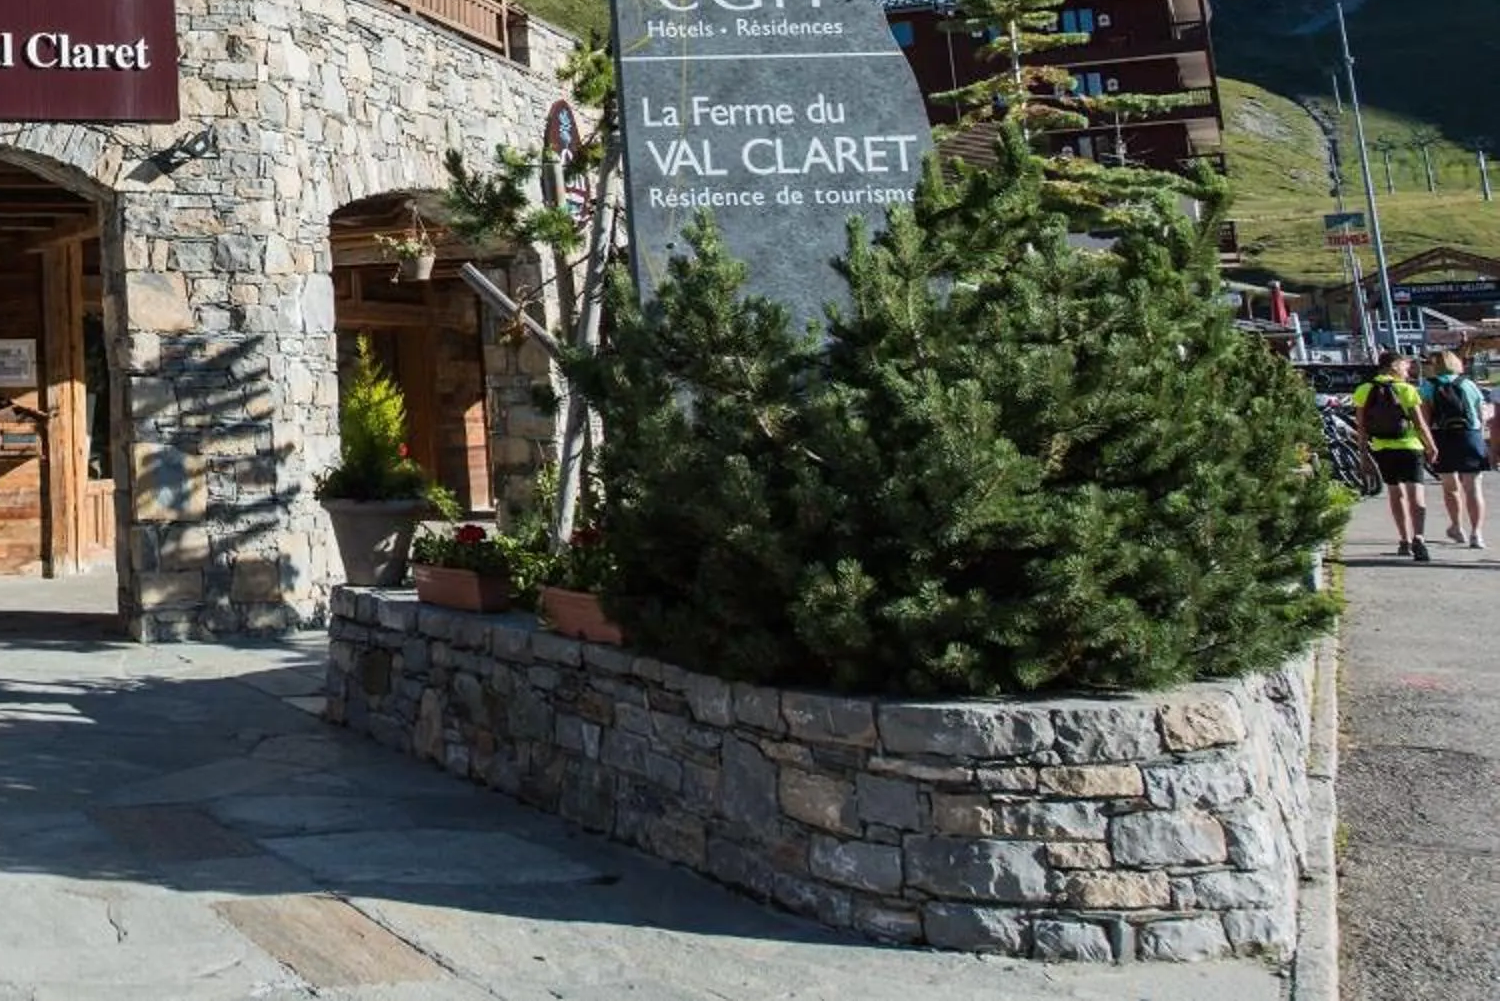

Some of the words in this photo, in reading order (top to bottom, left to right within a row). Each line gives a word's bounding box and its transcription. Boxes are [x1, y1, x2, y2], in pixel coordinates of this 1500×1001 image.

[647, 20, 714, 39] Hôtels
[736, 17, 843, 37] Résidences
[26, 32, 152, 70] Claret
[642, 97, 679, 127] La
[692, 96, 794, 126] Ferme
[807, 93, 845, 124] du
[648, 139, 728, 176] VAL
[742, 135, 917, 175] CLARET
[650, 188, 765, 208] Résidence
[777, 186, 803, 206] de
